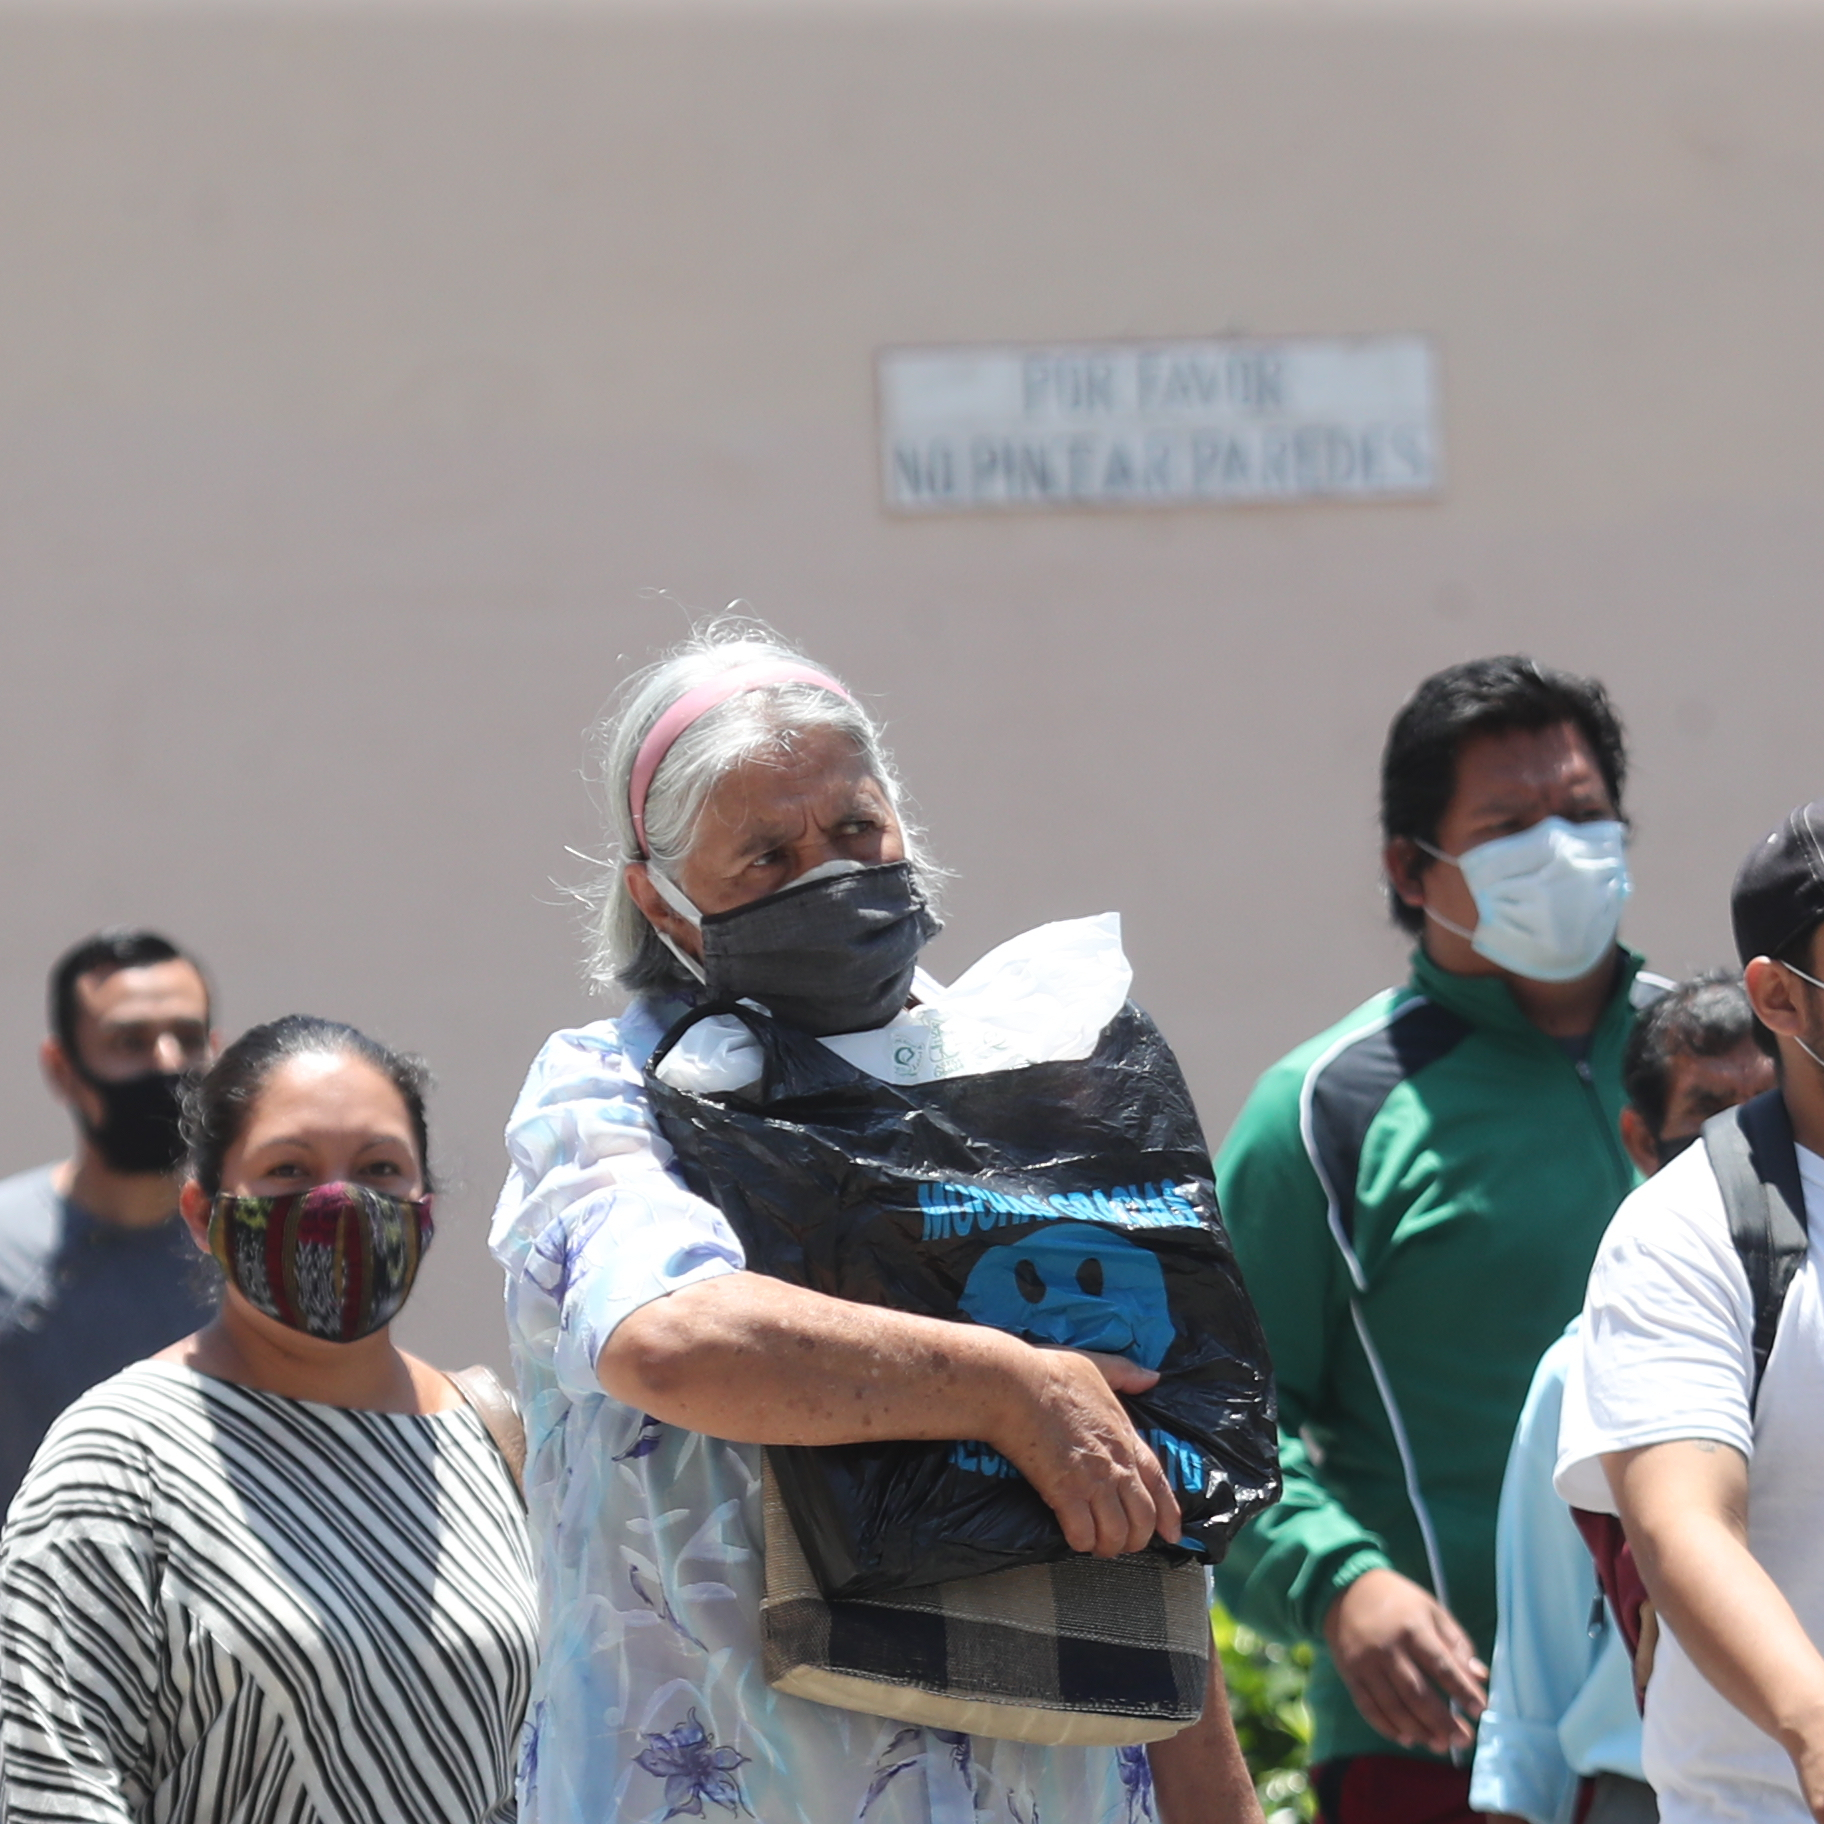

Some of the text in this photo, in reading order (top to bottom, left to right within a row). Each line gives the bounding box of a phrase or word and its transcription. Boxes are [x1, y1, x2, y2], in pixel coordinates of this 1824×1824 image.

[1022, 348, 1283, 414] POR FAVOR
[892, 422, 1429, 497] NO PINTAR PAREDES
[918, 1177, 1204, 1241] MUCHAS GRACIAS
